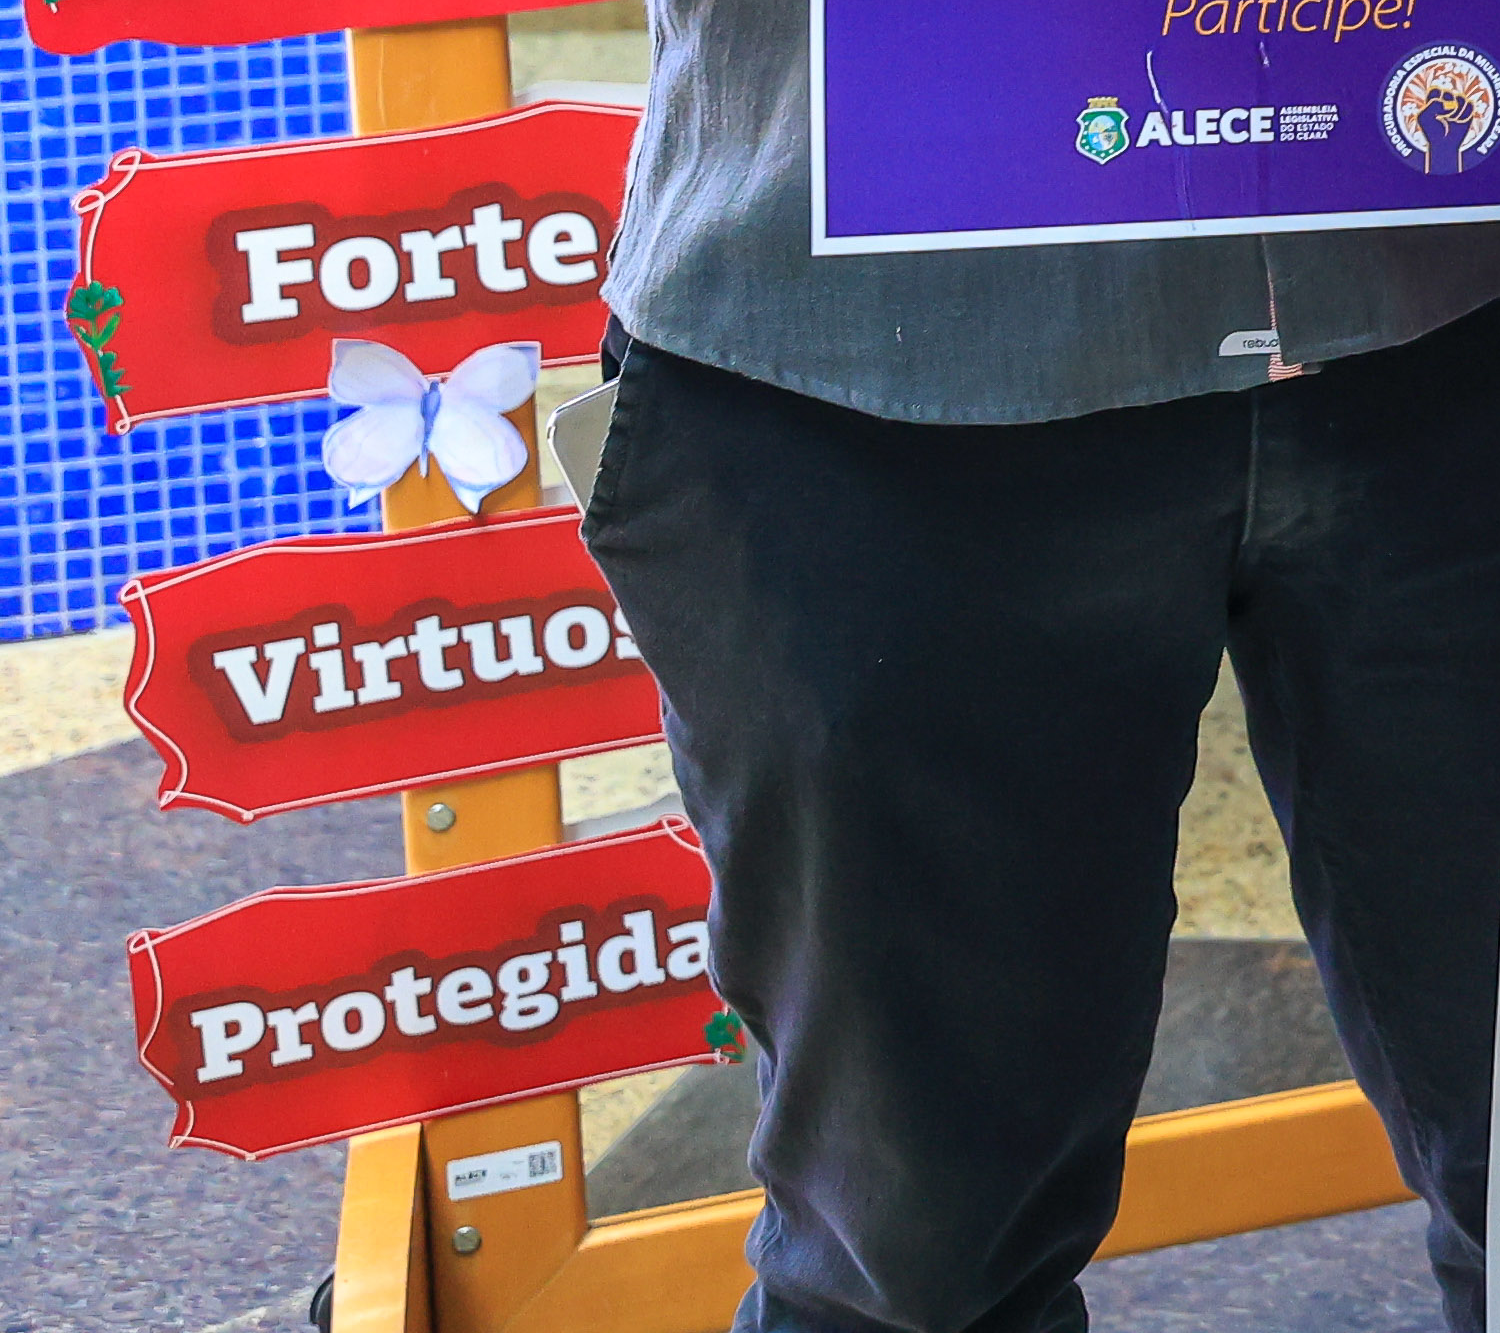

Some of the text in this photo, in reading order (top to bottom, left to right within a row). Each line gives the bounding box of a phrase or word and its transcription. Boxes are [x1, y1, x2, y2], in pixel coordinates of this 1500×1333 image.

[1457, 47, 1475, 61] DA
[1135, 106, 1275, 149] ALECE
[235, 202, 599, 325] Forte
[190, 909, 712, 1084] Protegida
